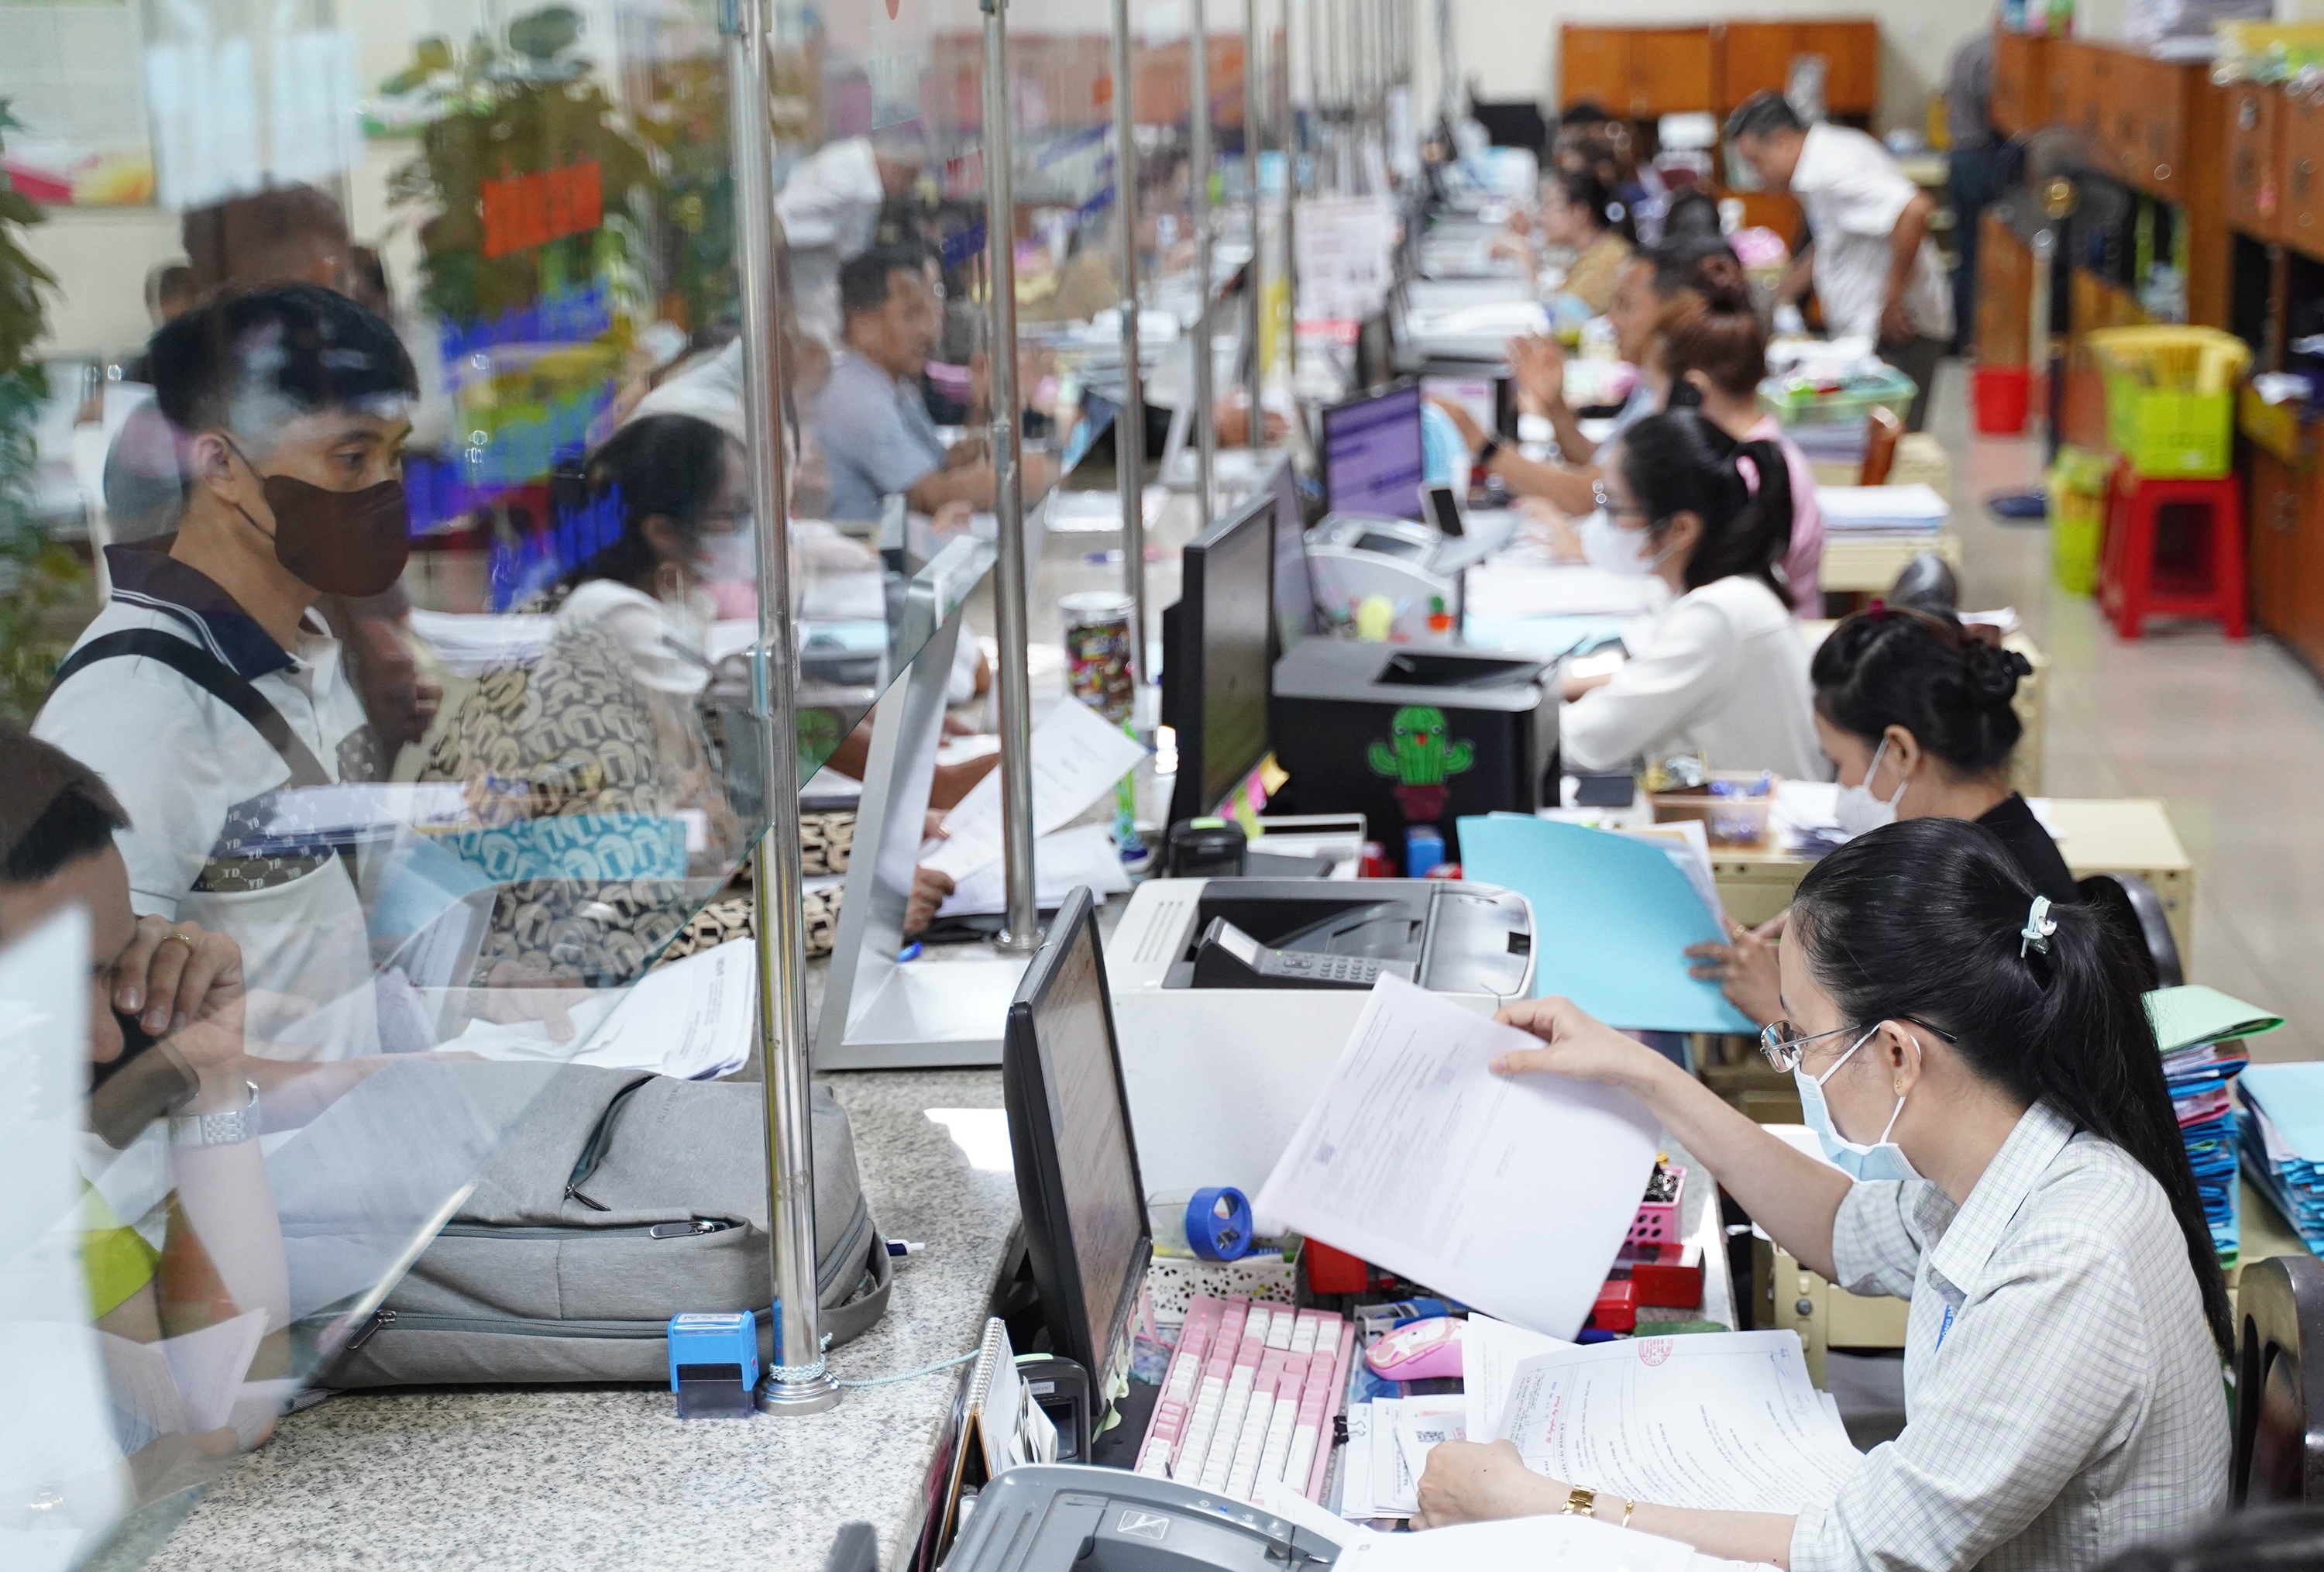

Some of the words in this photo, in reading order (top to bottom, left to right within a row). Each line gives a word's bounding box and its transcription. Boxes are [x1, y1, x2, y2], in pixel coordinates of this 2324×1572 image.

[246, 817, 260, 830] YD
[225, 838, 241, 850] YD
[249, 848, 262, 860] YD
[269, 858, 281, 870] YD
[222, 868, 240, 879] YD
[249, 878, 263, 889] YD
